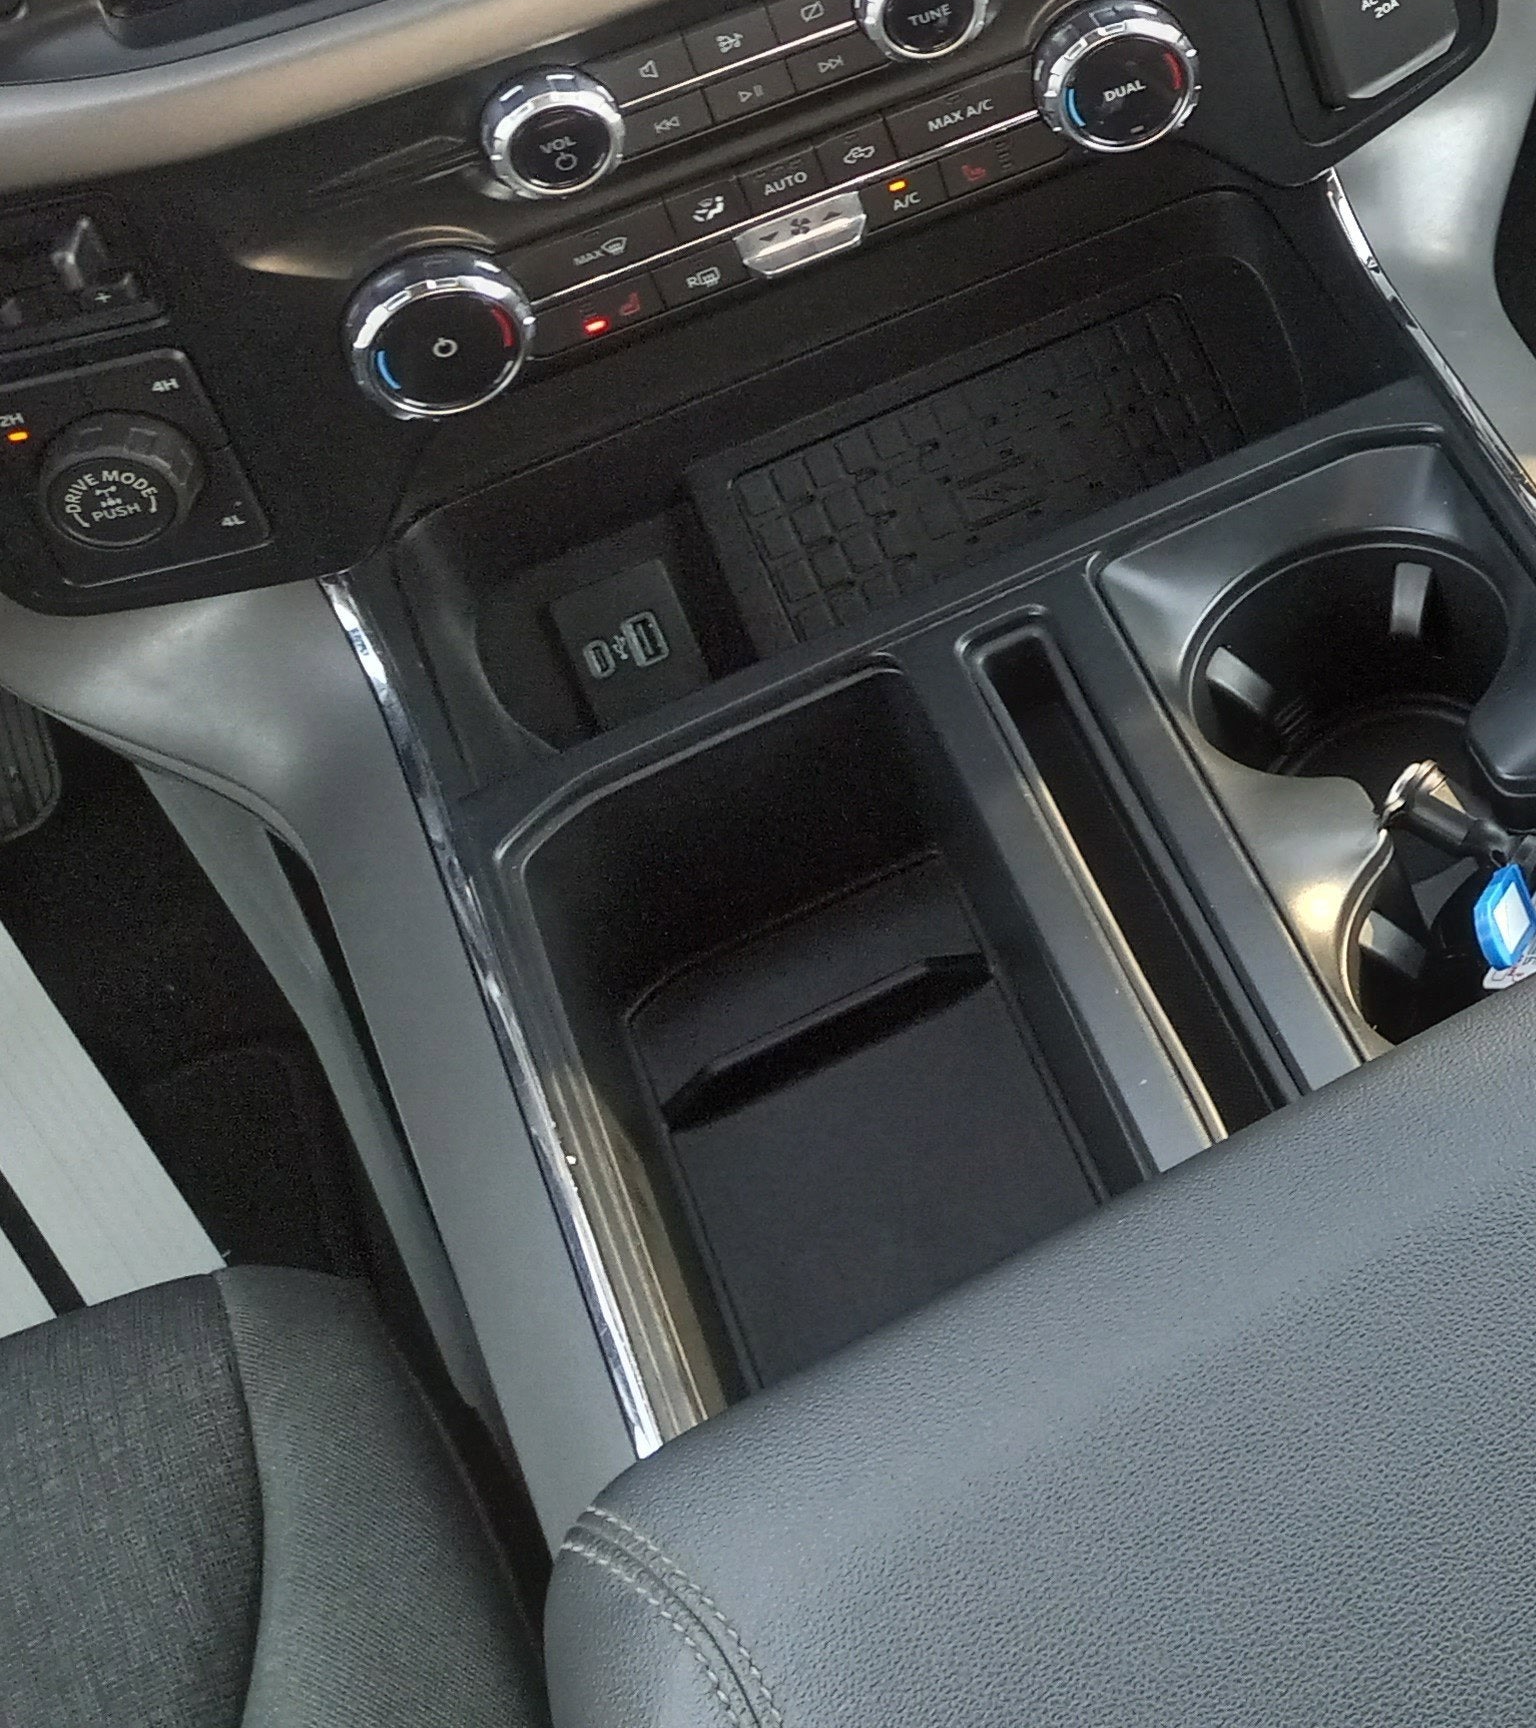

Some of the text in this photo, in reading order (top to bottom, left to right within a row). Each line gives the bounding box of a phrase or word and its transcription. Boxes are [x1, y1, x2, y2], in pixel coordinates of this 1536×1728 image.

[908, 3, 952, 27] TUNE
[1103, 79, 1147, 103] DUAL
[927, 98, 995, 132] MAX A/C
[539, 135, 577, 155] VOL
[763, 171, 808, 196] AUTO
[893, 192, 921, 211] A/C
[573, 249, 604, 266] MAX
[151, 377, 180, 393] 4H
[65, 470, 158, 514] DRIVE MODE
[91, 502, 142, 523] PUSH
